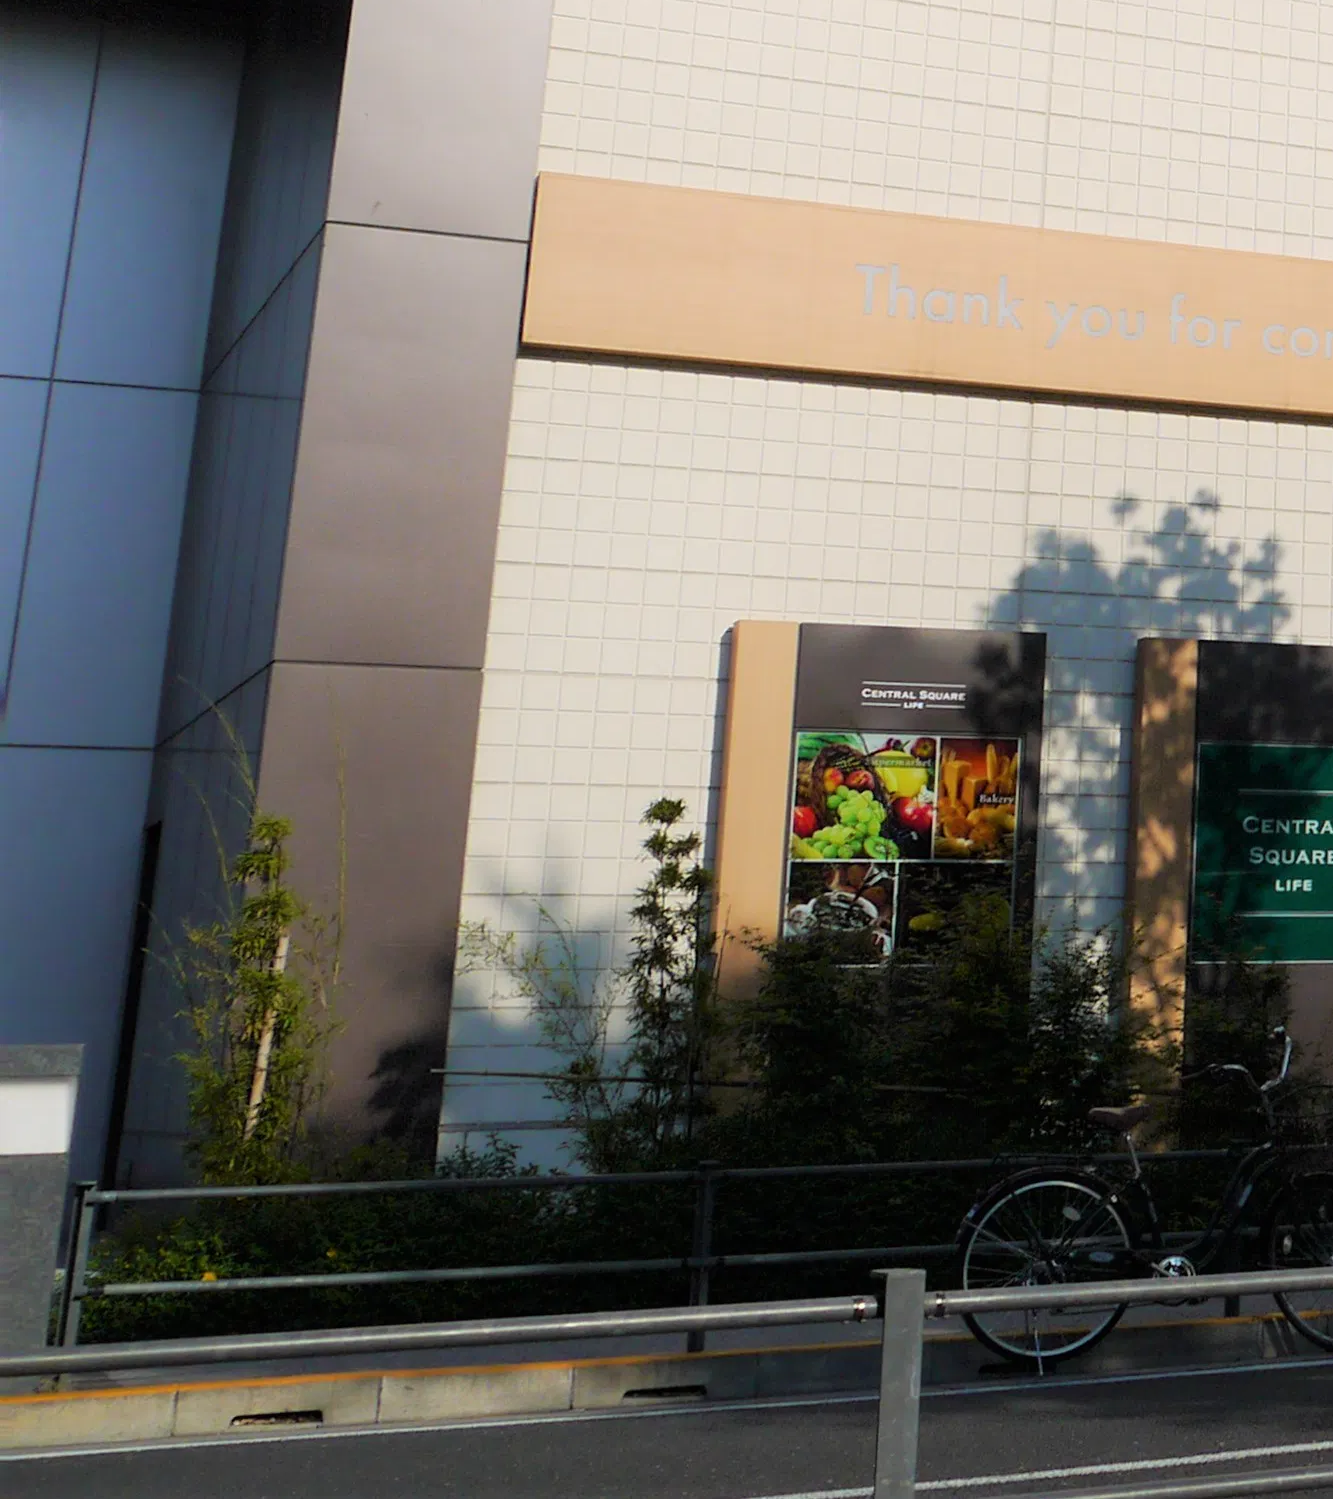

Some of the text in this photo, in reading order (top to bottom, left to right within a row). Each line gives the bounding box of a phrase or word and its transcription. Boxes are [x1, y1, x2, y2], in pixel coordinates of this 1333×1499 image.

[855, 263, 1025, 330] Thank
[1045, 301, 1146, 349] you
[1169, 293, 1242, 349] for
[861, 687, 967, 702] CENTRAL SQUARE
[903, 701, 925, 710] LIFE
[979, 792, 1016, 805] Bakery
[1275, 879, 1313, 892] LIFE
